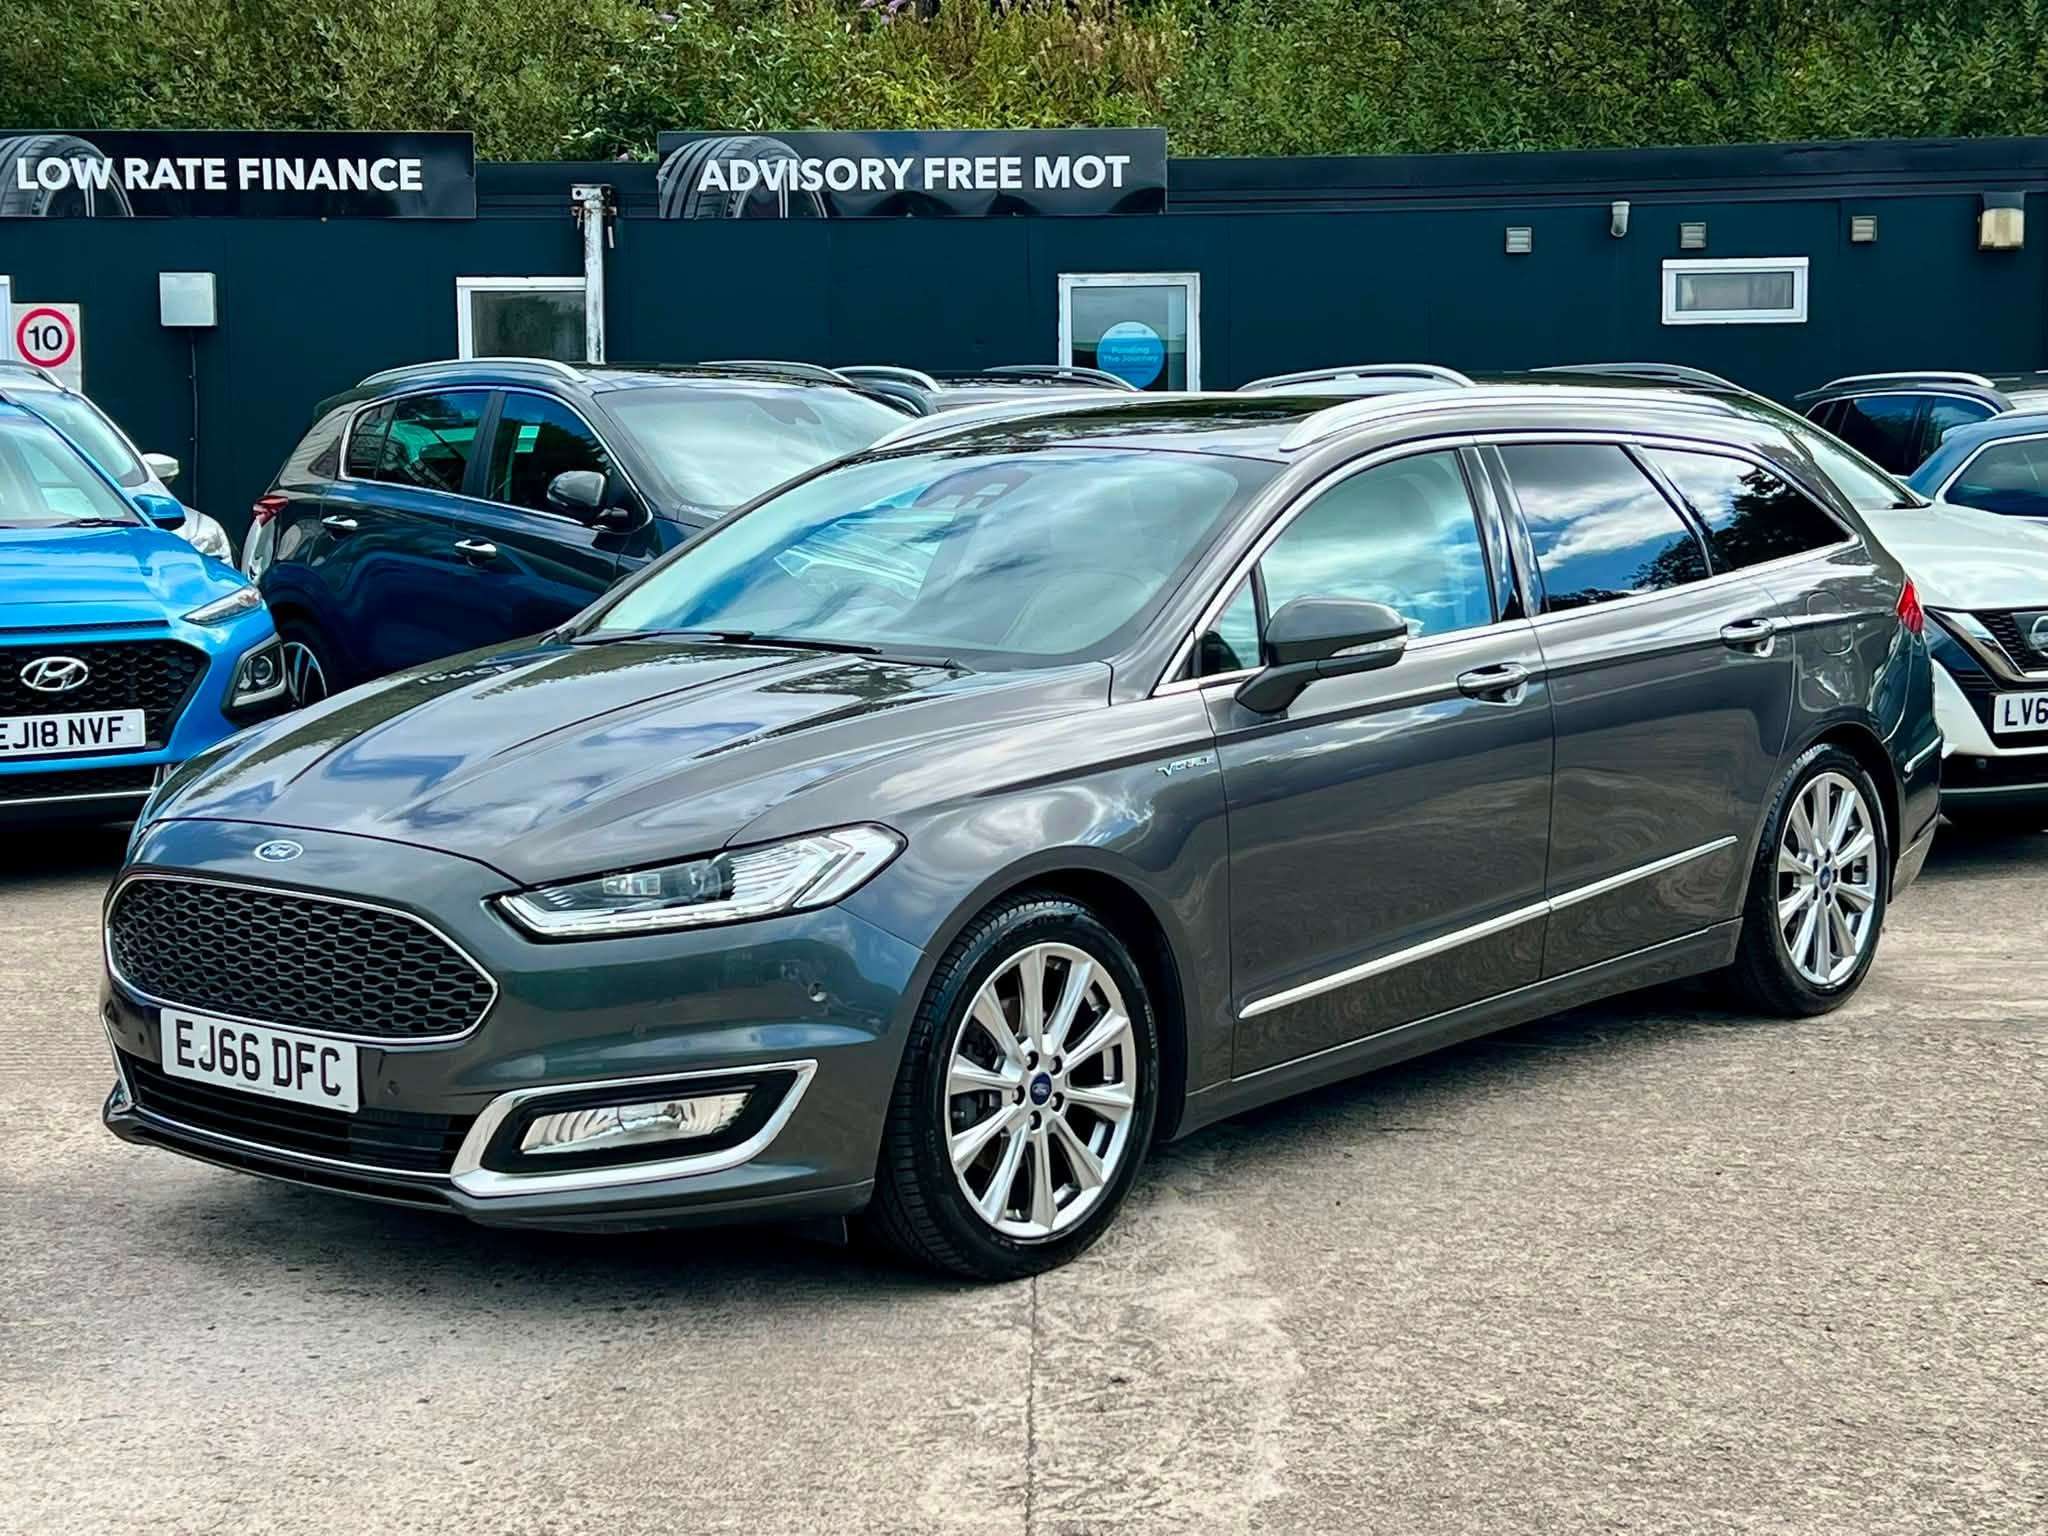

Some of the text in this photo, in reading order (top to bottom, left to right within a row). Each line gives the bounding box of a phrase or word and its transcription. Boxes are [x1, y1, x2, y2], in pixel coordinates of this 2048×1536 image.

[17, 157, 423, 190] LOW RATE FINANCE
[697, 154, 1131, 192] ADVISORY FREE MOT
[27, 325, 61, 351] 10
[0, 716, 124, 750] EJ18 NVF
[176, 1019, 342, 1096] EJ66 DFC
